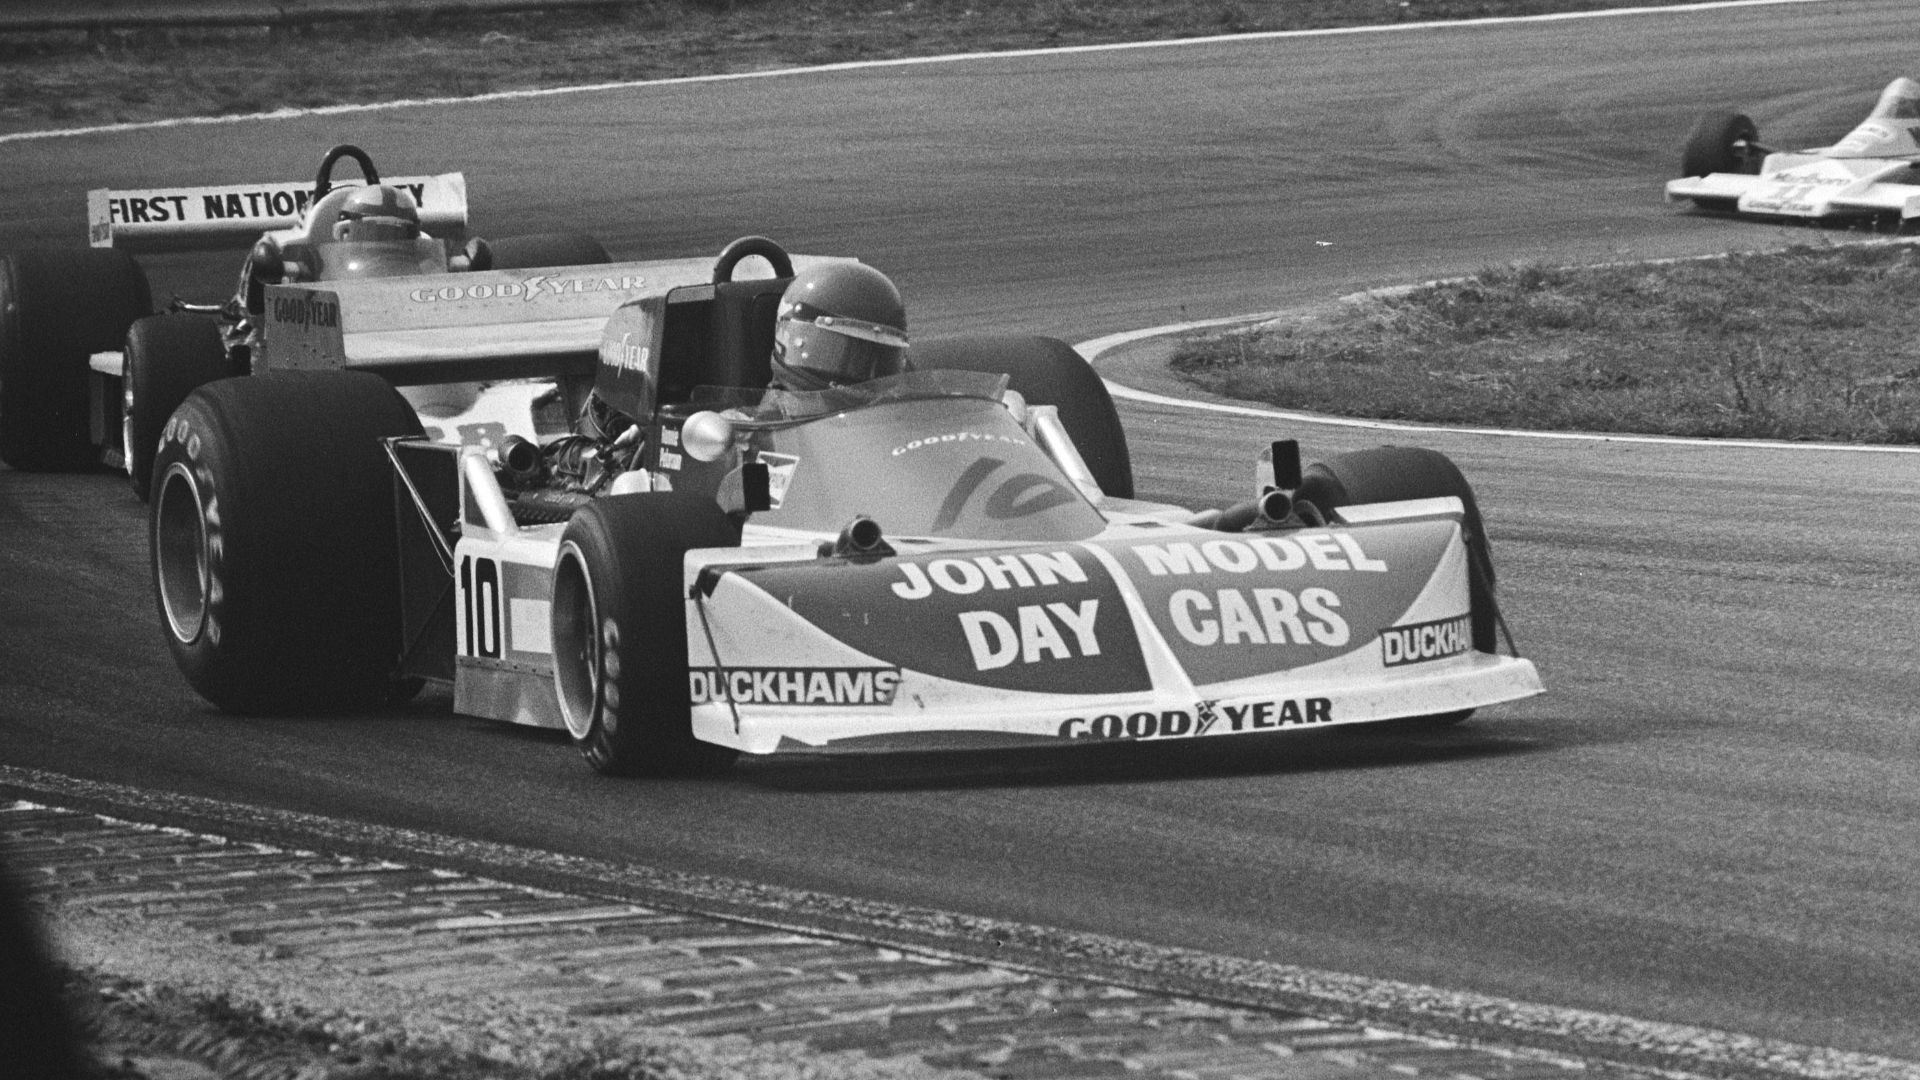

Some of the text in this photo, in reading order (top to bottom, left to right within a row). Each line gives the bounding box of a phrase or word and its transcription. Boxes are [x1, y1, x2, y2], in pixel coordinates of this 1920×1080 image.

[109, 196, 188, 223] FIRST
[930, 456, 1077, 533] 10
[891, 550, 1088, 600] JOHN
[1132, 534, 1388, 577] MODEL
[460, 554, 501, 659] 10
[1168, 587, 1351, 648] CARS
[958, 599, 1101, 672] DAY
[689, 671, 900, 704] DUCKHAMS
